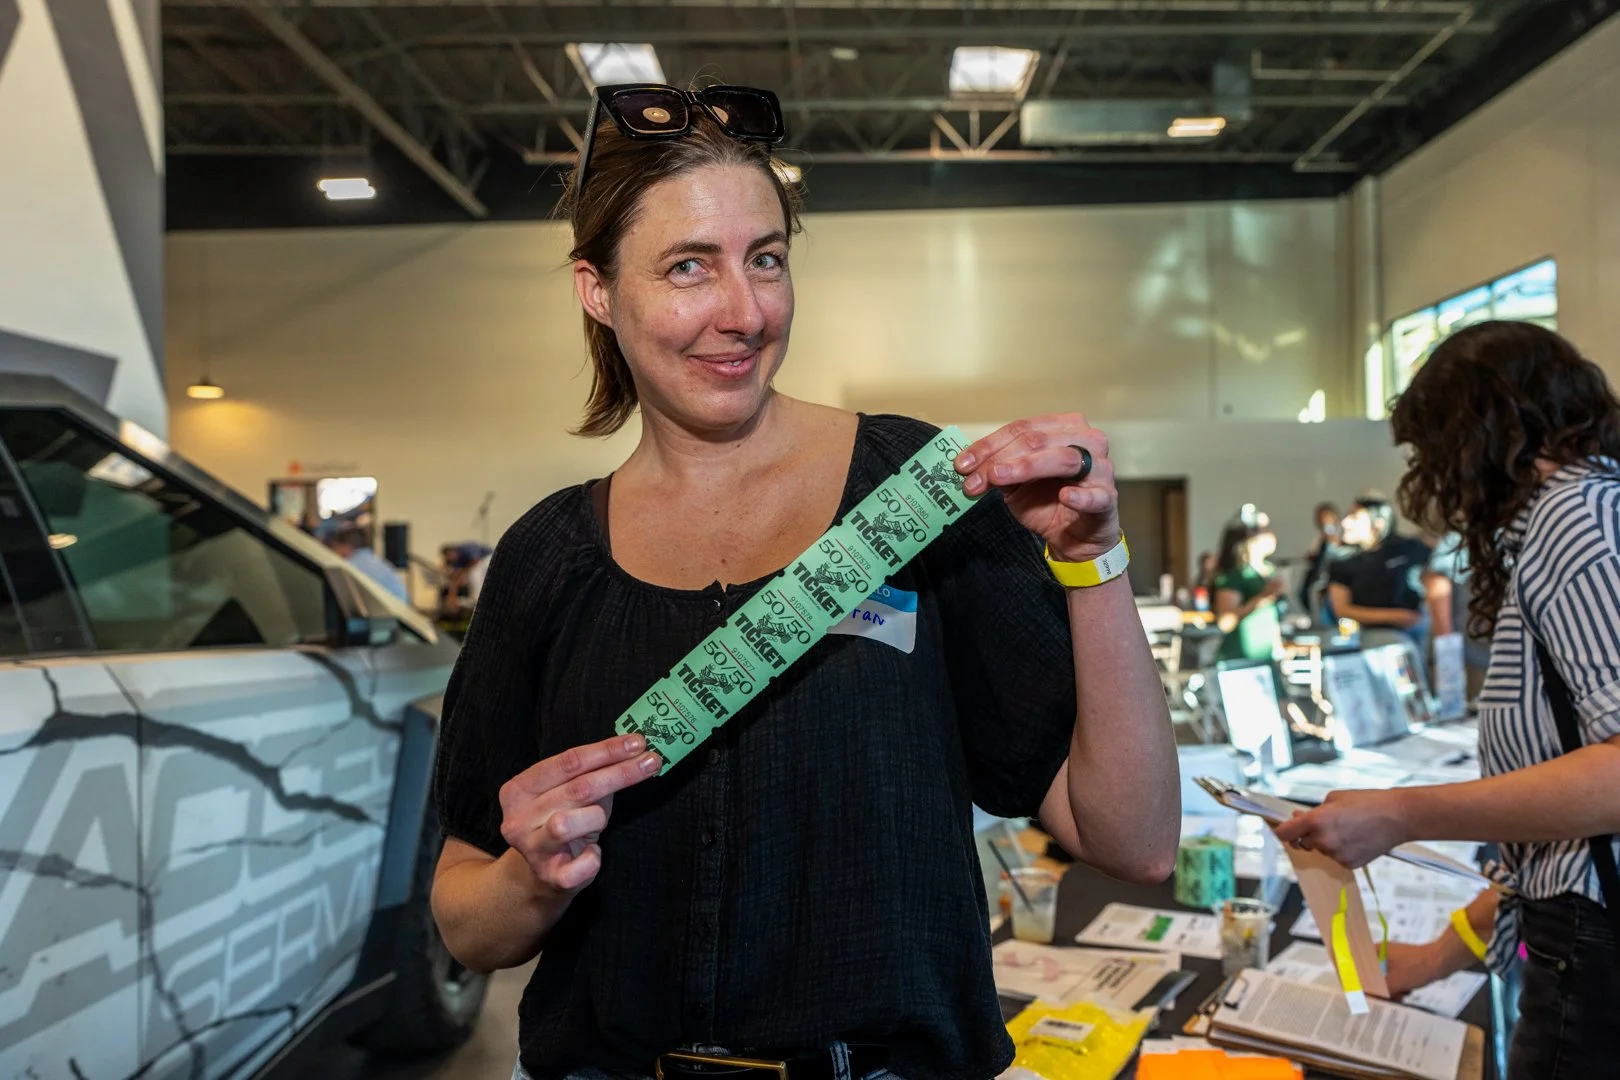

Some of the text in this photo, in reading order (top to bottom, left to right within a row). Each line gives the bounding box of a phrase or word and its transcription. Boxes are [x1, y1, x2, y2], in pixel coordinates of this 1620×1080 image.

[876, 488, 927, 543] 50/50
[908, 460, 961, 517] TICKET
[819, 539, 869, 593] 50/50
[850, 511, 903, 568] TICKET
[761, 590, 811, 644] 50/50
[793, 561, 845, 619] TICKET
[703, 640, 753, 695] 50/50
[734, 612, 787, 670] TICKET
[646, 691, 695, 745] 50/50
[677, 663, 729, 719] TICKET
